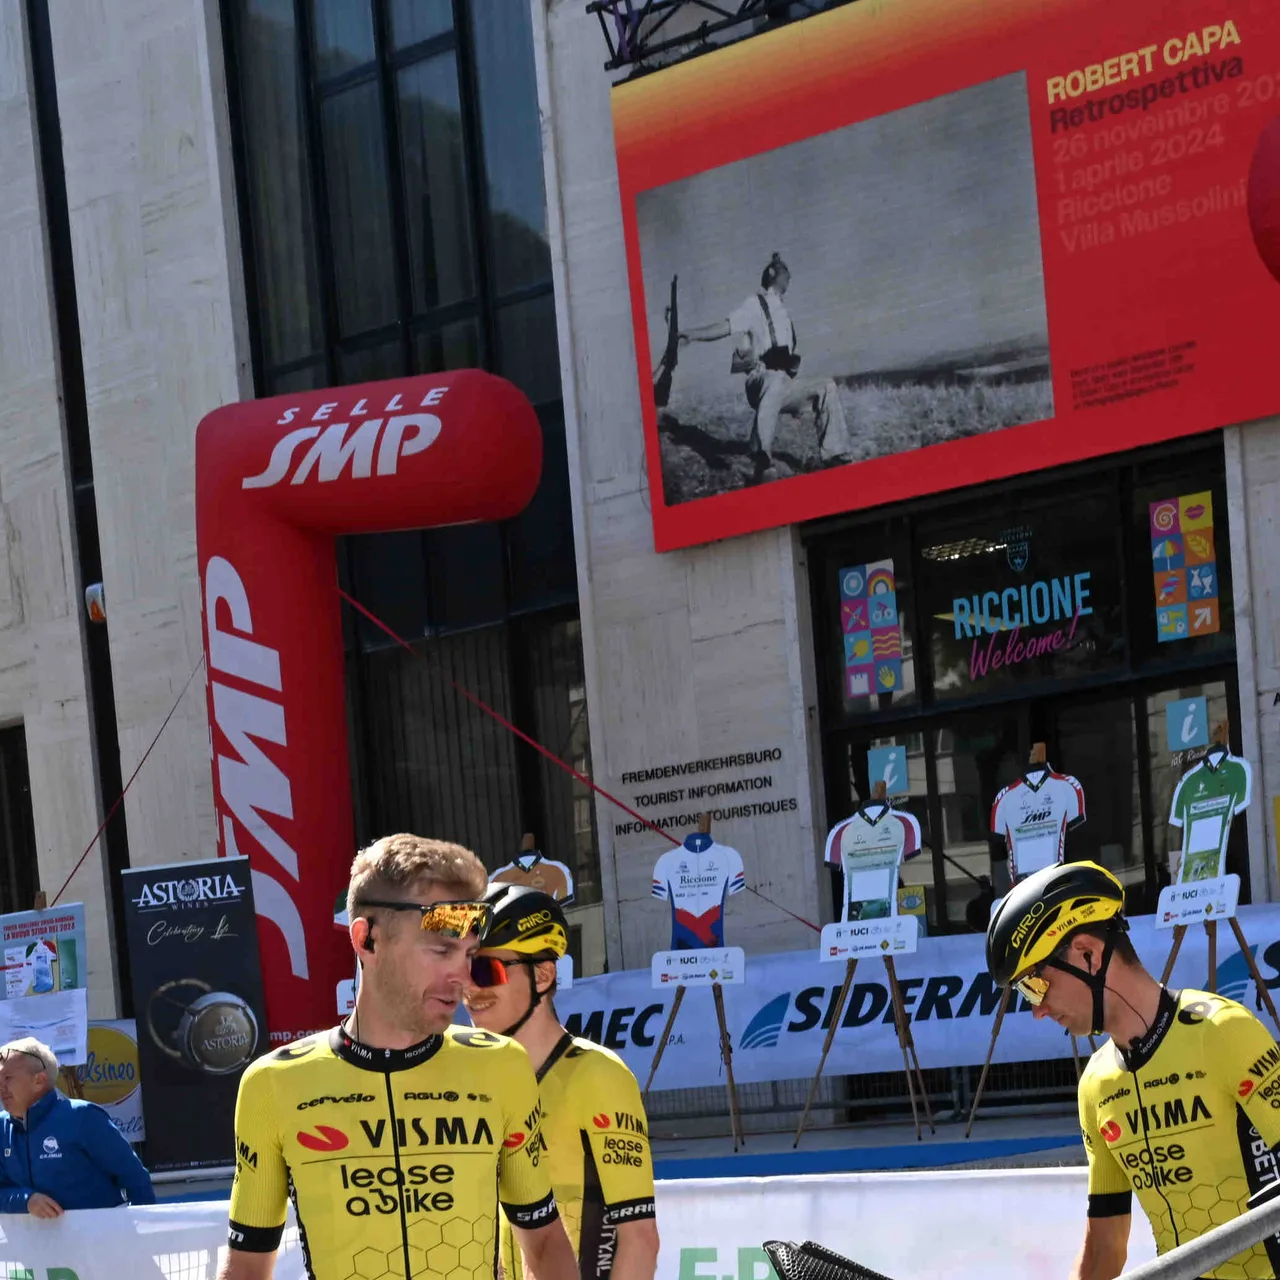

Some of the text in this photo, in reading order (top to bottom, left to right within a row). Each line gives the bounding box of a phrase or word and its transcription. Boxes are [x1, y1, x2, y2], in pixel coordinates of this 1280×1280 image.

[1047, 19, 1241, 104] ROBERT CAPA
[1049, 55, 1244, 134] Retrospettiva
[1053, 137, 1088, 165] 26
[1094, 95, 1230, 147] novembre
[1073, 123, 1225, 190] aprile 2024
[1056, 172, 1171, 224] Riccione
[1059, 179, 1248, 252] Villa Mussolini
[277, 387, 448, 425] SELLE
[242, 414, 442, 489] SMP
[953, 571, 1093, 640] RICCIONE
[970, 604, 1081, 681] Welcome!
[622, 748, 782, 784] FREMDENVERKEHRSBURO
[634, 776, 773, 807] TOURIST INFORMATION
[706, 798, 798, 823] TOURISTIQUES
[133, 874, 245, 908] ASTORIA
[680, 874, 717, 884] Riccione
[171, 902, 209, 911] WINES
[517, 909, 552, 932] GIRO
[1011, 902, 1044, 949] GIRO
[1056, 917, 1078, 933] VISMA
[201, 1031, 250, 1052] ASTORIA
[351, 1044, 372, 1060] VISMA
[77, 1051, 135, 1082] elsineo
[404, 1092, 442, 1101] AGU
[1098, 1087, 1131, 1108] cervélo
[1144, 1076, 1169, 1090] AGU
[297, 1093, 376, 1112] cervélo
[1125, 1095, 1213, 1135] VISMA
[359, 1117, 494, 1149] VISMA
[604, 1136, 643, 1154] lease
[1119, 1143, 1185, 1170] lease
[341, 1164, 455, 1189] lease
